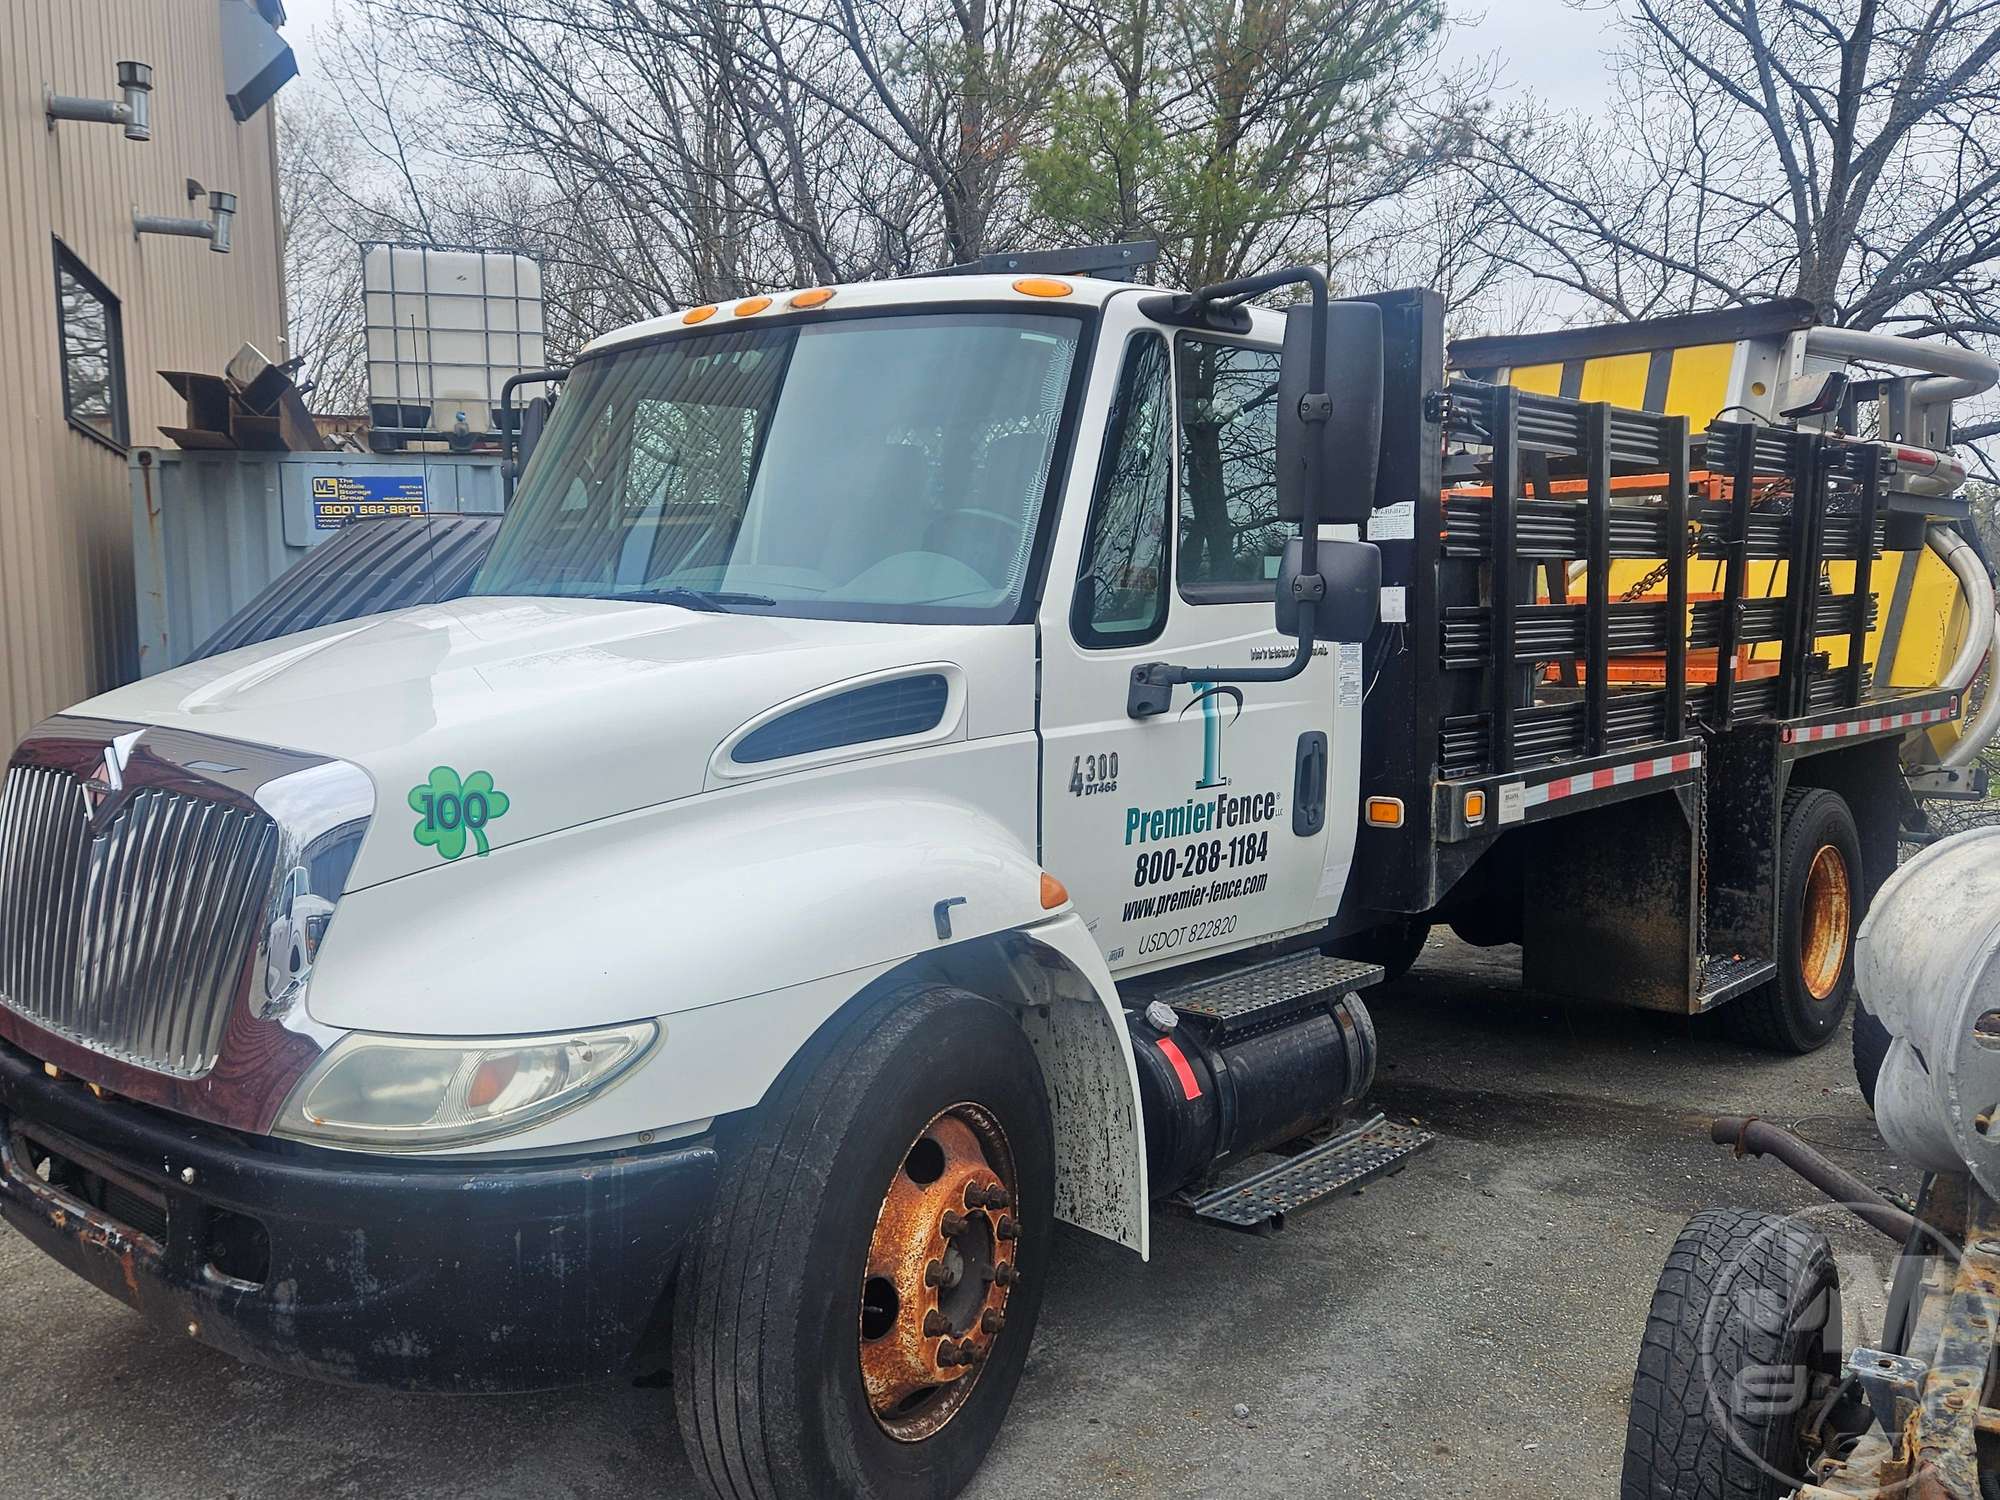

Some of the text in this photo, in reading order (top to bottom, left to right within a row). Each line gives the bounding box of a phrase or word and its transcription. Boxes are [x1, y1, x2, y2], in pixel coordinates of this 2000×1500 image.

[320, 505, 355, 515] (800)
[1069, 752, 1118, 797] 4300
[1085, 781, 1117, 796] DT466
[421, 792, 488, 830] 100
[1134, 831, 1268, 887] 800-288-1184
[1122, 873, 1269, 922] www.premier-fence.com
[1138, 926, 1188, 955] USDOT
[1188, 914, 1238, 942] 822820
